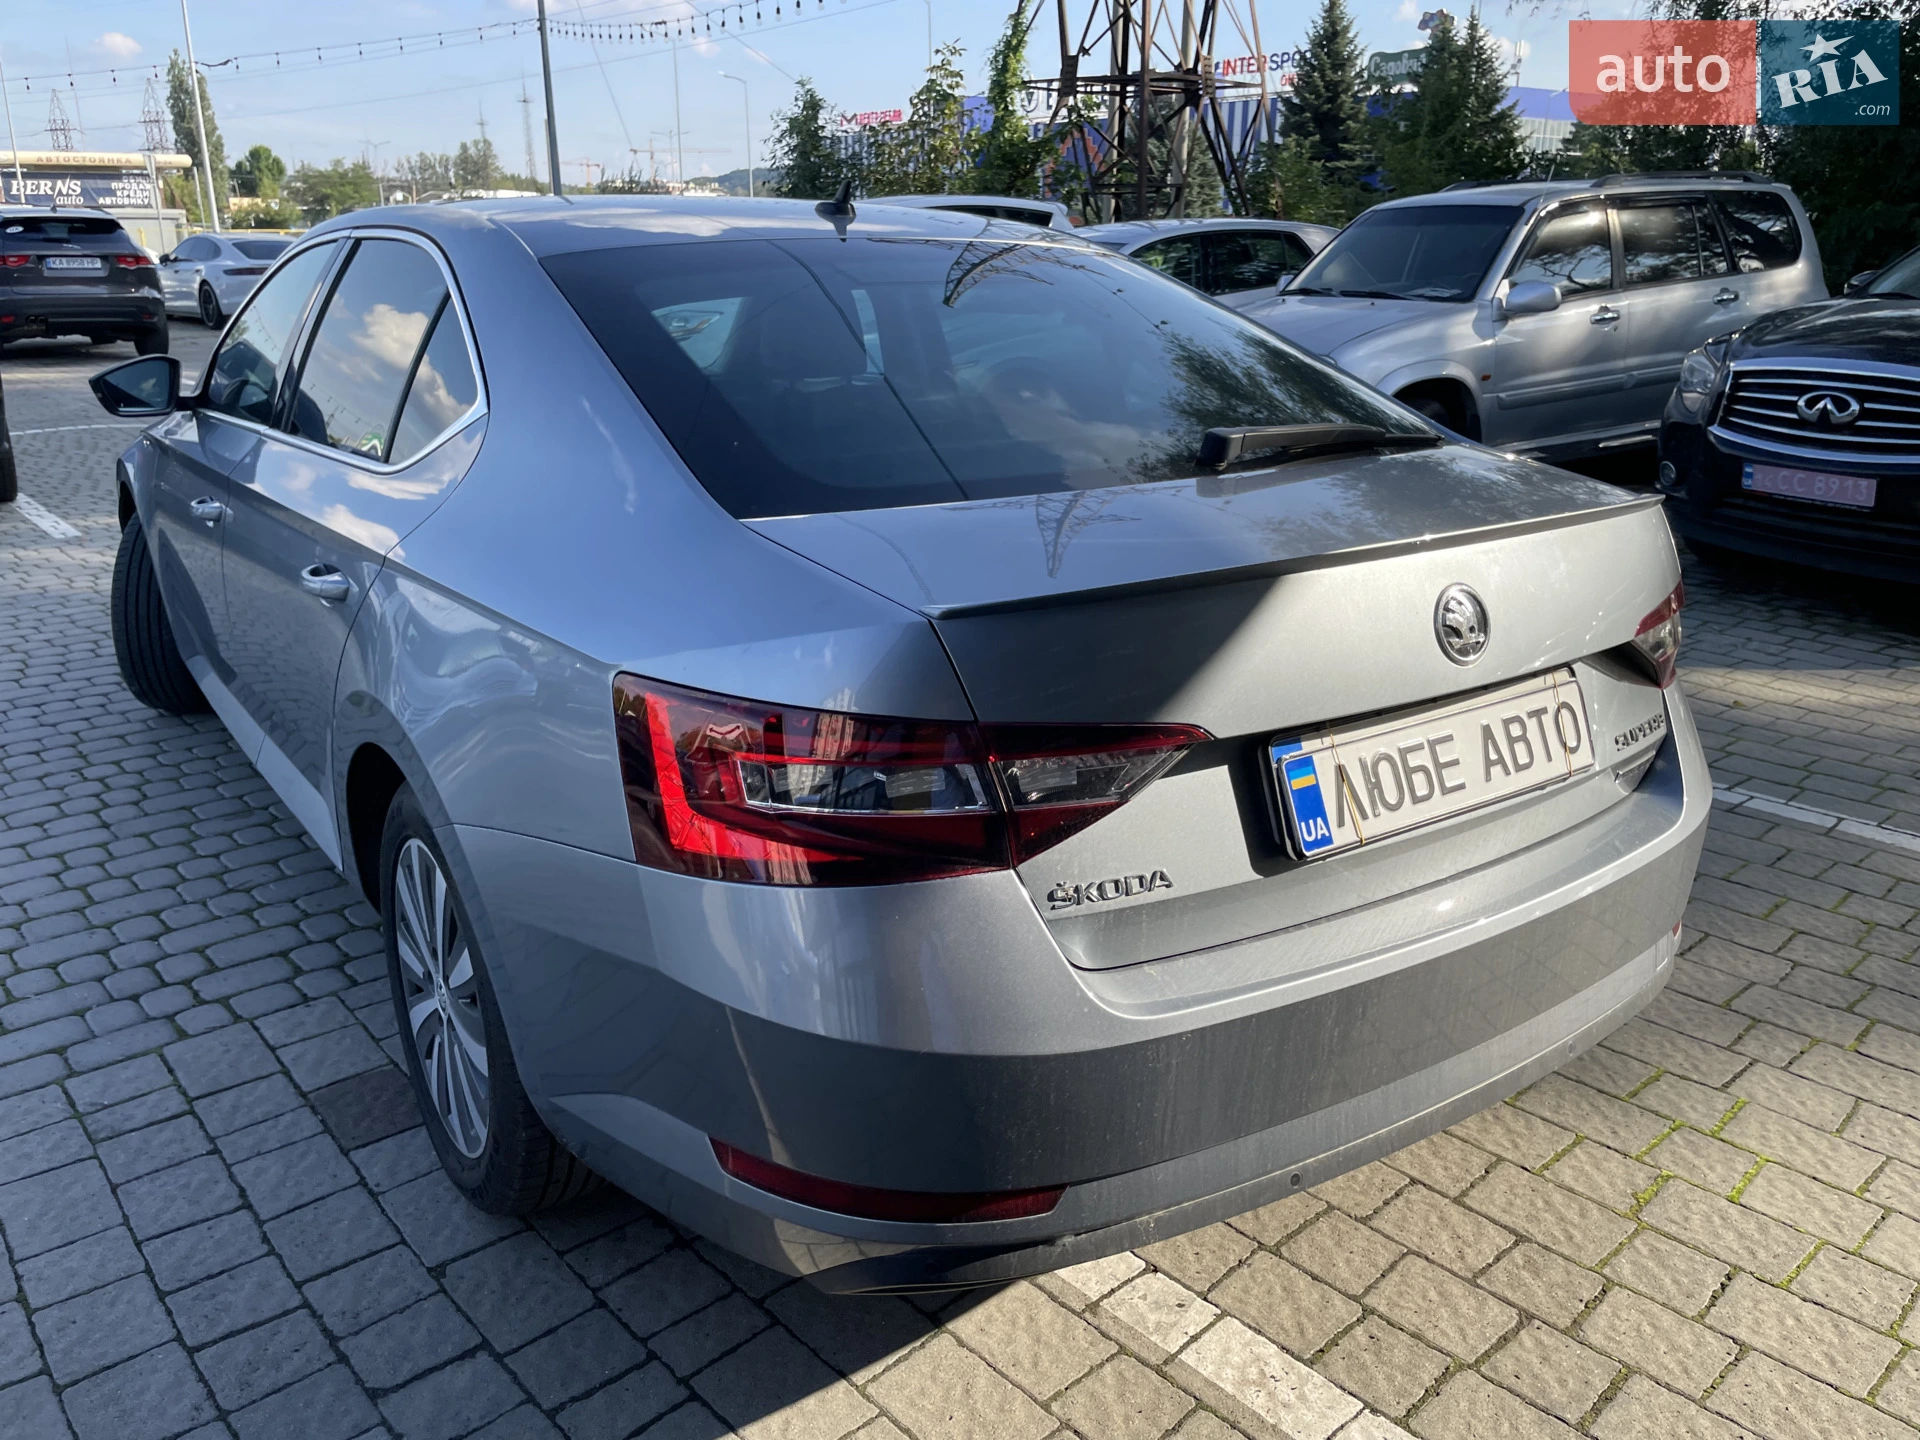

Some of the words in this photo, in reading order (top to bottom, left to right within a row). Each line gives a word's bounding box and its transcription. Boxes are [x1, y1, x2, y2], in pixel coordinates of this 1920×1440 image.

[36, 155, 132, 165] АВТОСТОЯНКА
[10, 175, 82, 198] BERNS
[116, 190, 150, 199] КРЕДИ
[55, 194, 84, 205] auto
[98, 197, 149, 206] АВТОВИКУ
[51, 258, 64, 266] KA
[1776, 470, 1806, 493] CC
[1814, 475, 1869, 501] 8913
[1333, 732, 1466, 828] ЛЮБЕ
[1480, 701, 1582, 782] АВТО
[1300, 817, 1330, 842] UA
[1047, 868, 1175, 911] ŠKODA
